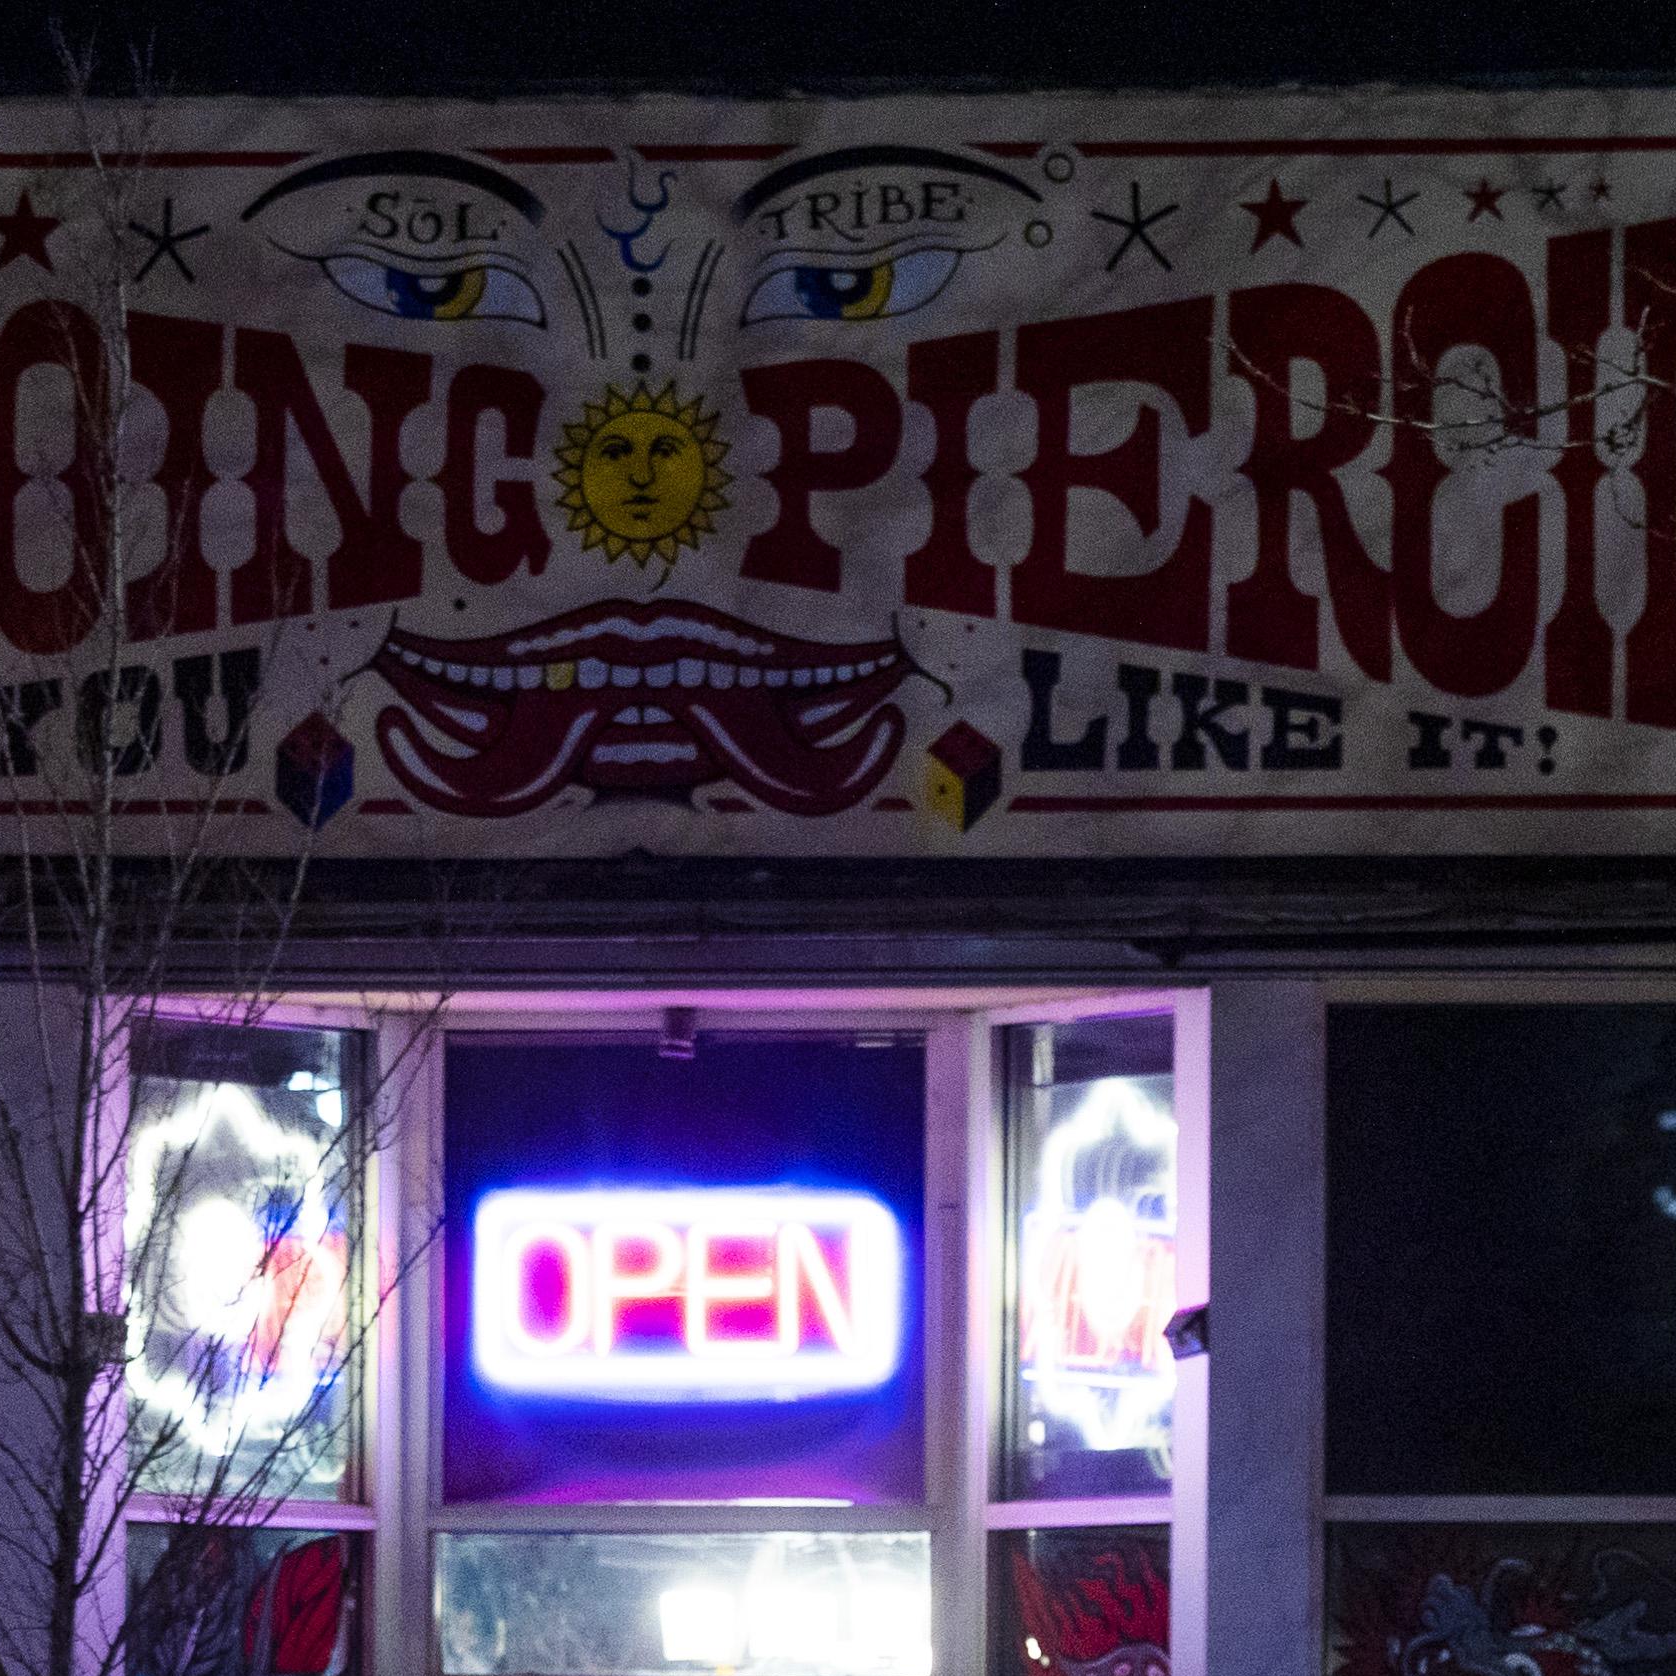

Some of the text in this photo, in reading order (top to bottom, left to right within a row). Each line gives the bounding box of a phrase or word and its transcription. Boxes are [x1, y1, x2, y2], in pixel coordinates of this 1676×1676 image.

[1022, 648, 1343, 770] LIKE
[1409, 709, 1559, 776] IT!
[501, 1220, 870, 1360] OPEN
